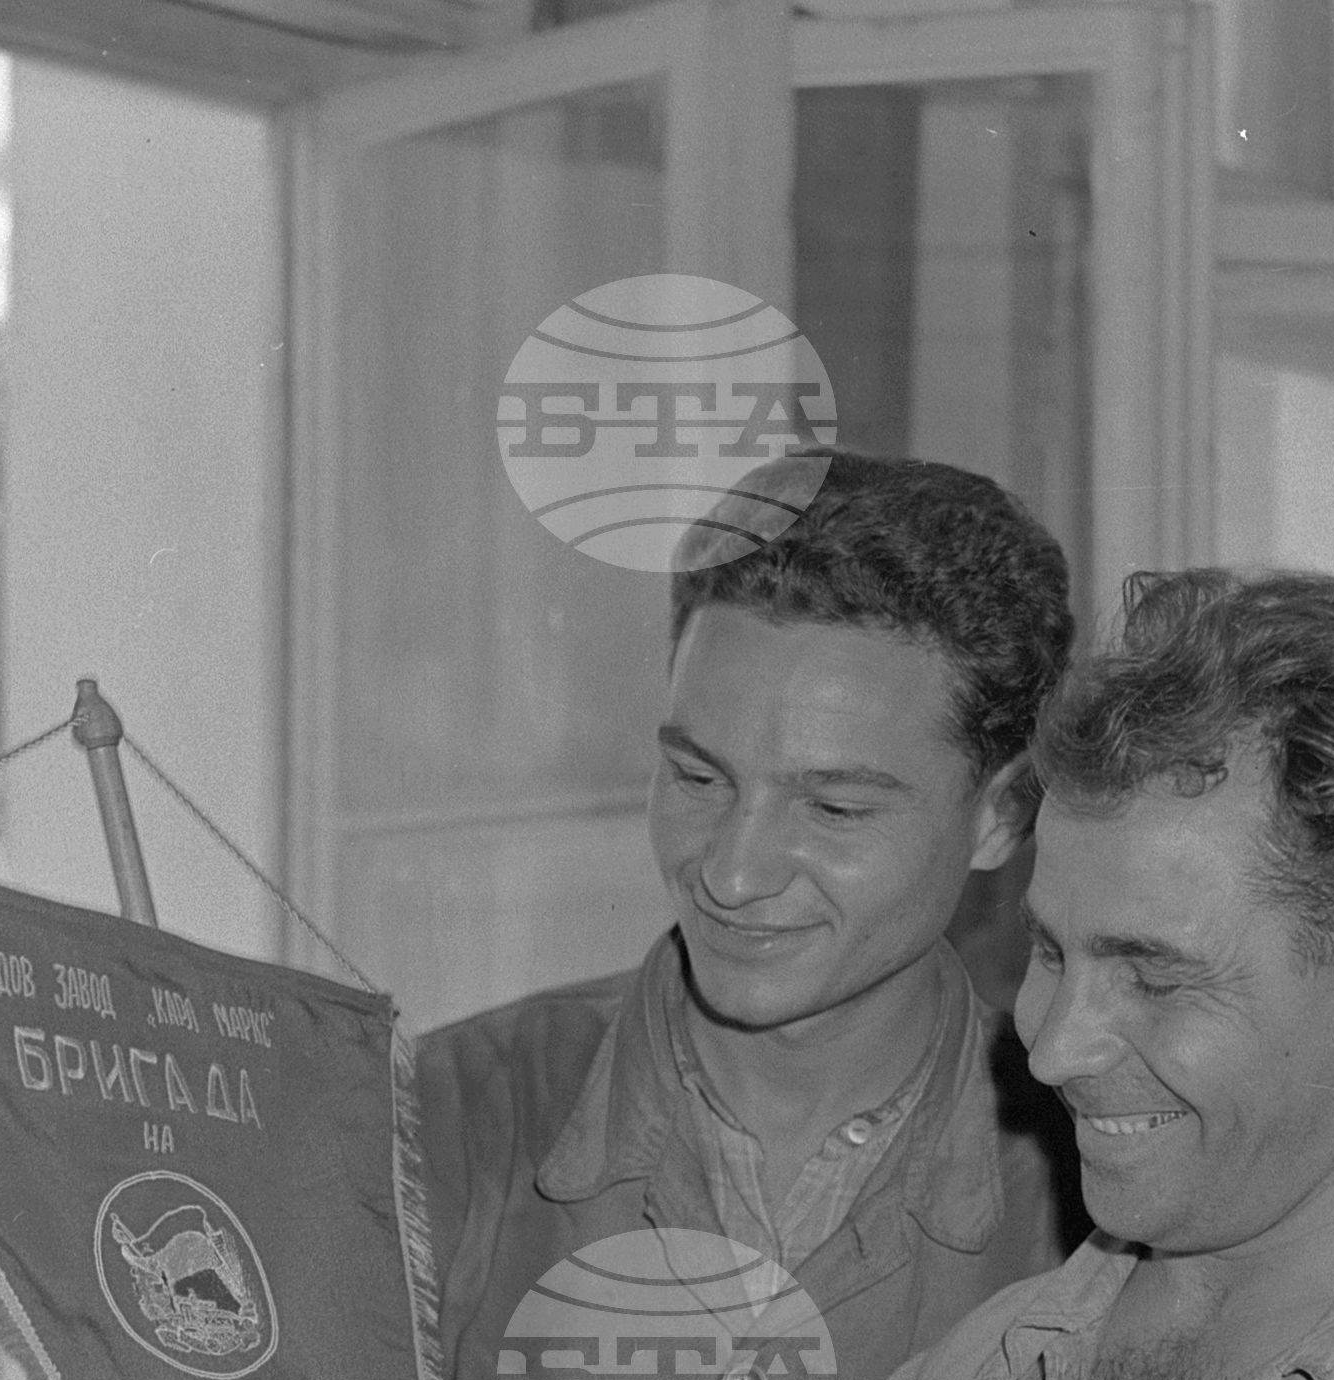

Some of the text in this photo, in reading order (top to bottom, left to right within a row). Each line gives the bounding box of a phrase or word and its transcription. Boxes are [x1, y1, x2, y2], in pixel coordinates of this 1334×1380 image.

[53, 963, 116, 1021] ЗАВОД
[14, 1025, 264, 1131] БРИГАДА
[143, 1121, 174, 1154] НА
